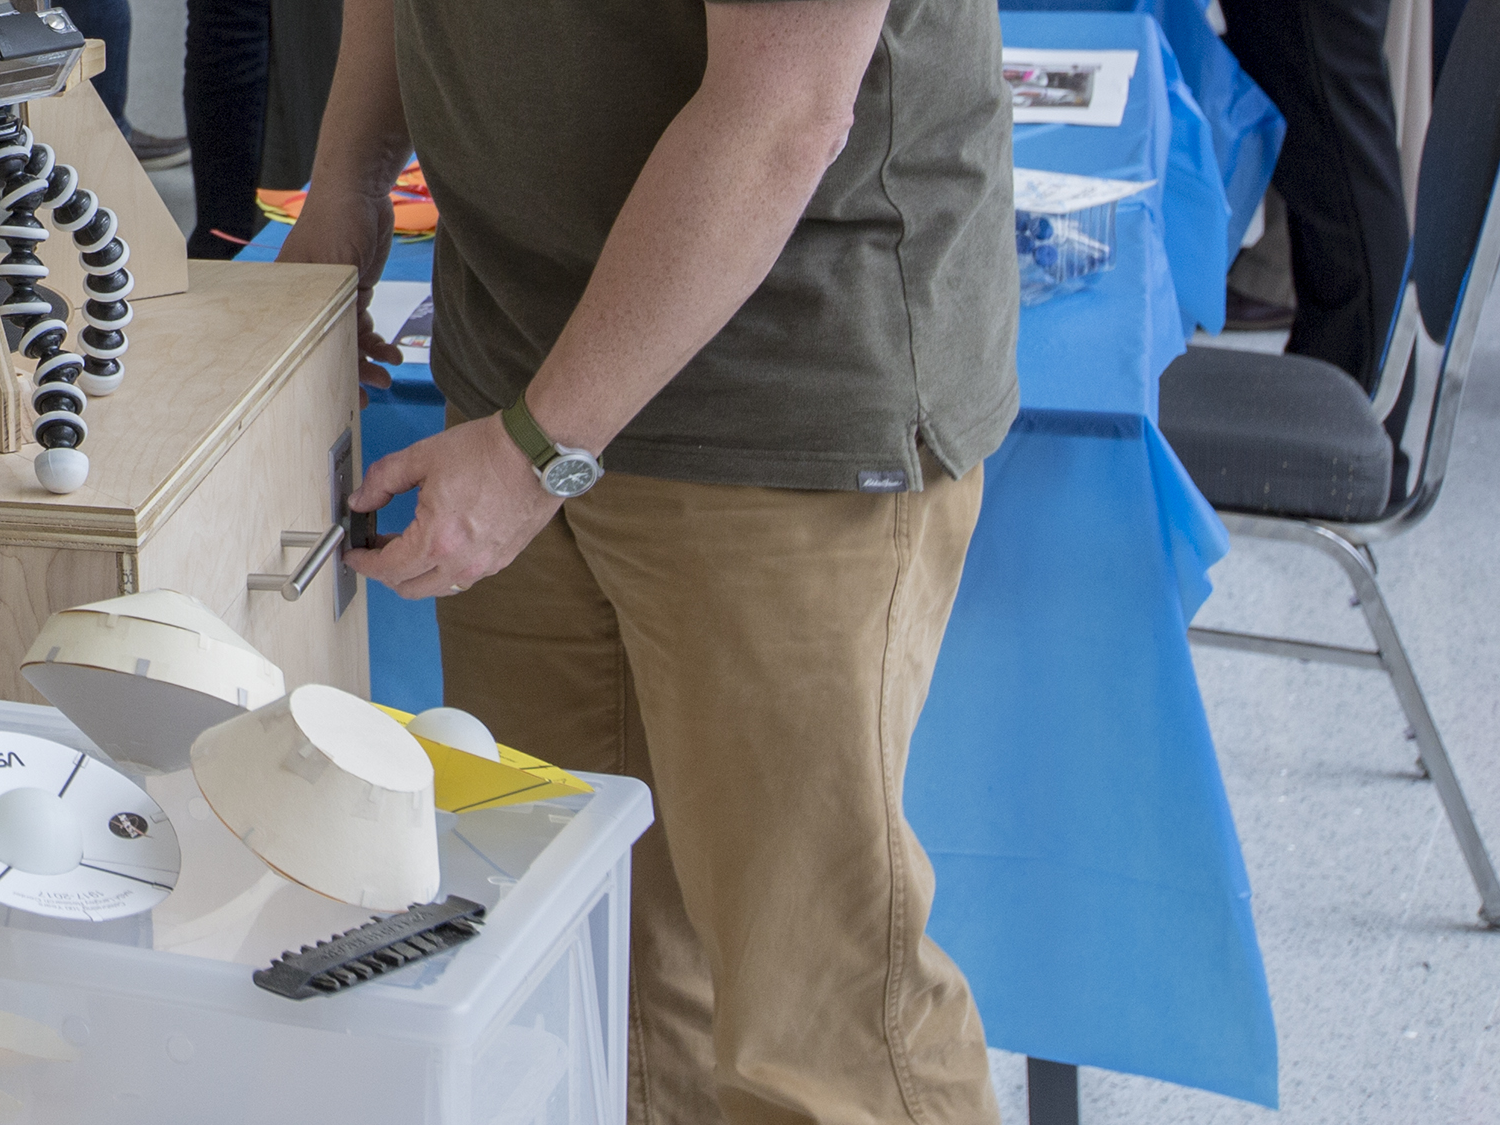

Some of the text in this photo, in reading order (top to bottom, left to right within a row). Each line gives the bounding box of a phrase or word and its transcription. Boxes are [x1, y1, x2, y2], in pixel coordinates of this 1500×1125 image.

[12, 891, 42, 903] Center
[38, 890, 104, 900] 1917-2017
[115, 889, 134, 900] NASA
[39, 903, 62, 911] Years
[82, 901, 126, 911] Celebrating
